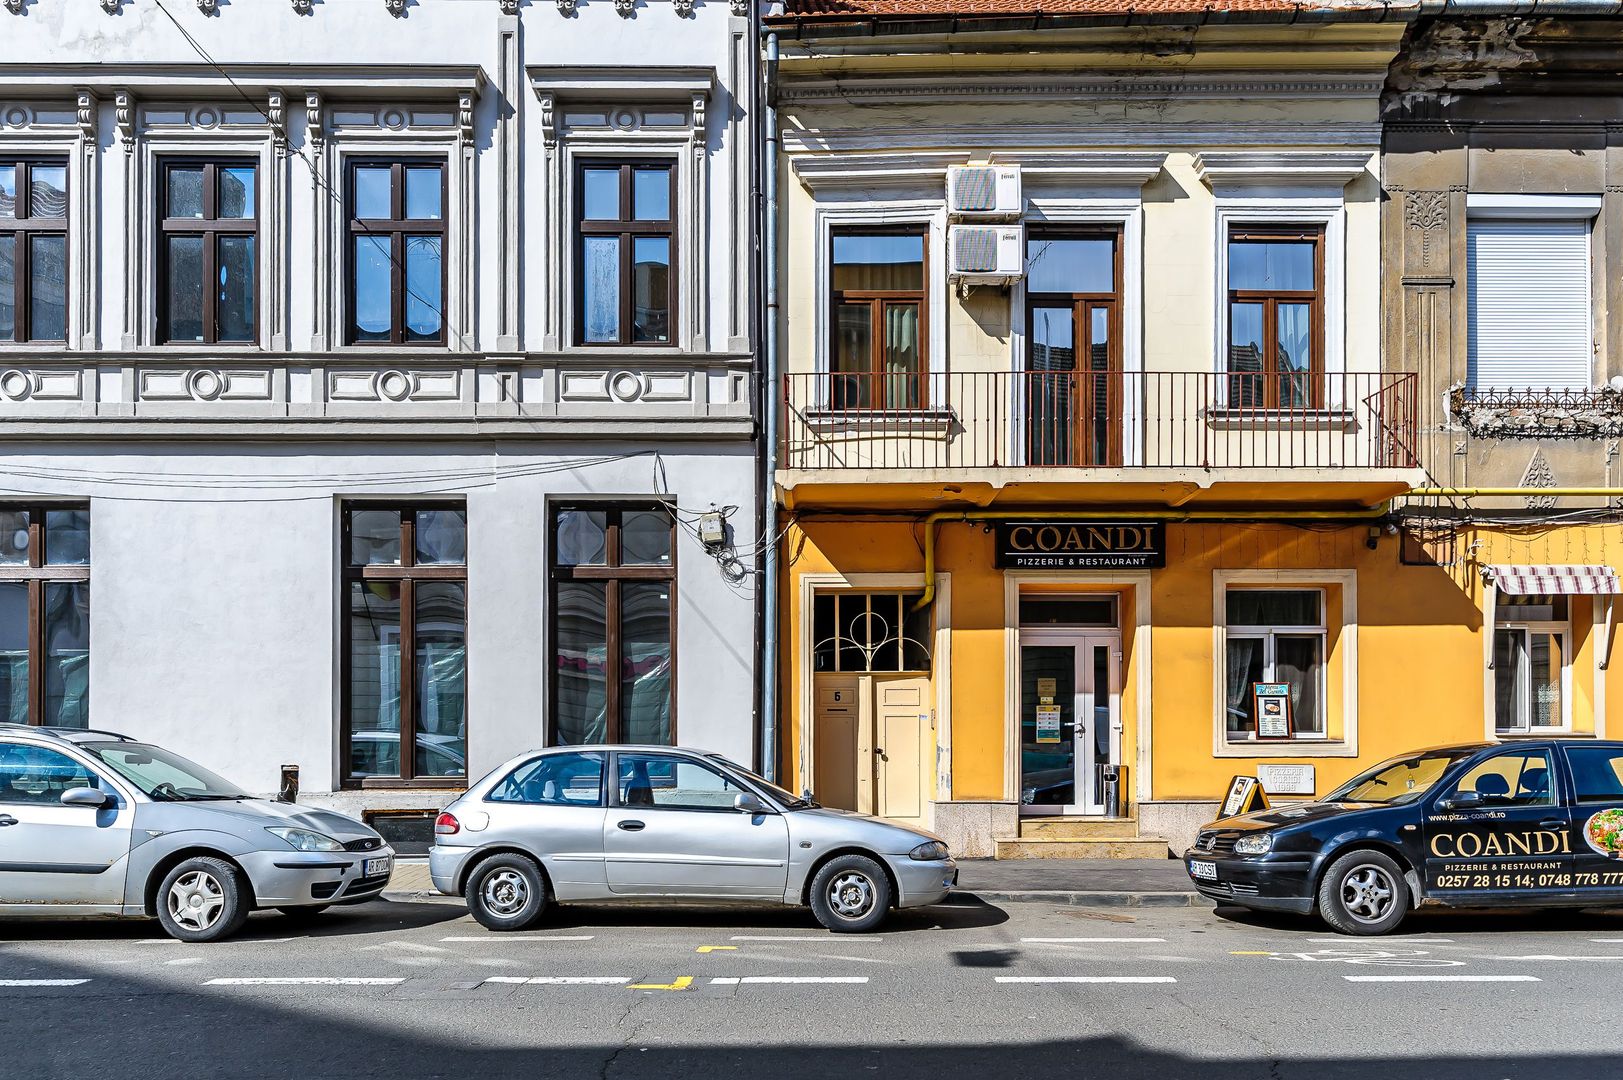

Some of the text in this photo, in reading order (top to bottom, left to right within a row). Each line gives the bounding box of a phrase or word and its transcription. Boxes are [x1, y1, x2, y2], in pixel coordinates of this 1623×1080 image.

[1009, 526, 1154, 551] COANDI
[1017, 558, 1146, 566] PIZZERIE & RESTAURANT
[1268, 768, 1304, 776] PIZZERIA
[1428, 811, 1506, 822] www.pizza-coandi.ro
[1430, 830, 1572, 858] COANDI
[1491, 863, 1498, 871] &
[1501, 862, 1562, 870] RESTAURANT
[1437, 875, 1470, 887] 0257
[1473, 875, 1490, 887] 28
[1494, 875, 1510, 887] 15
[1515, 874, 1534, 888] 14;
[1538, 873, 1571, 887] 0748
[1575, 872, 1599, 885] 778
